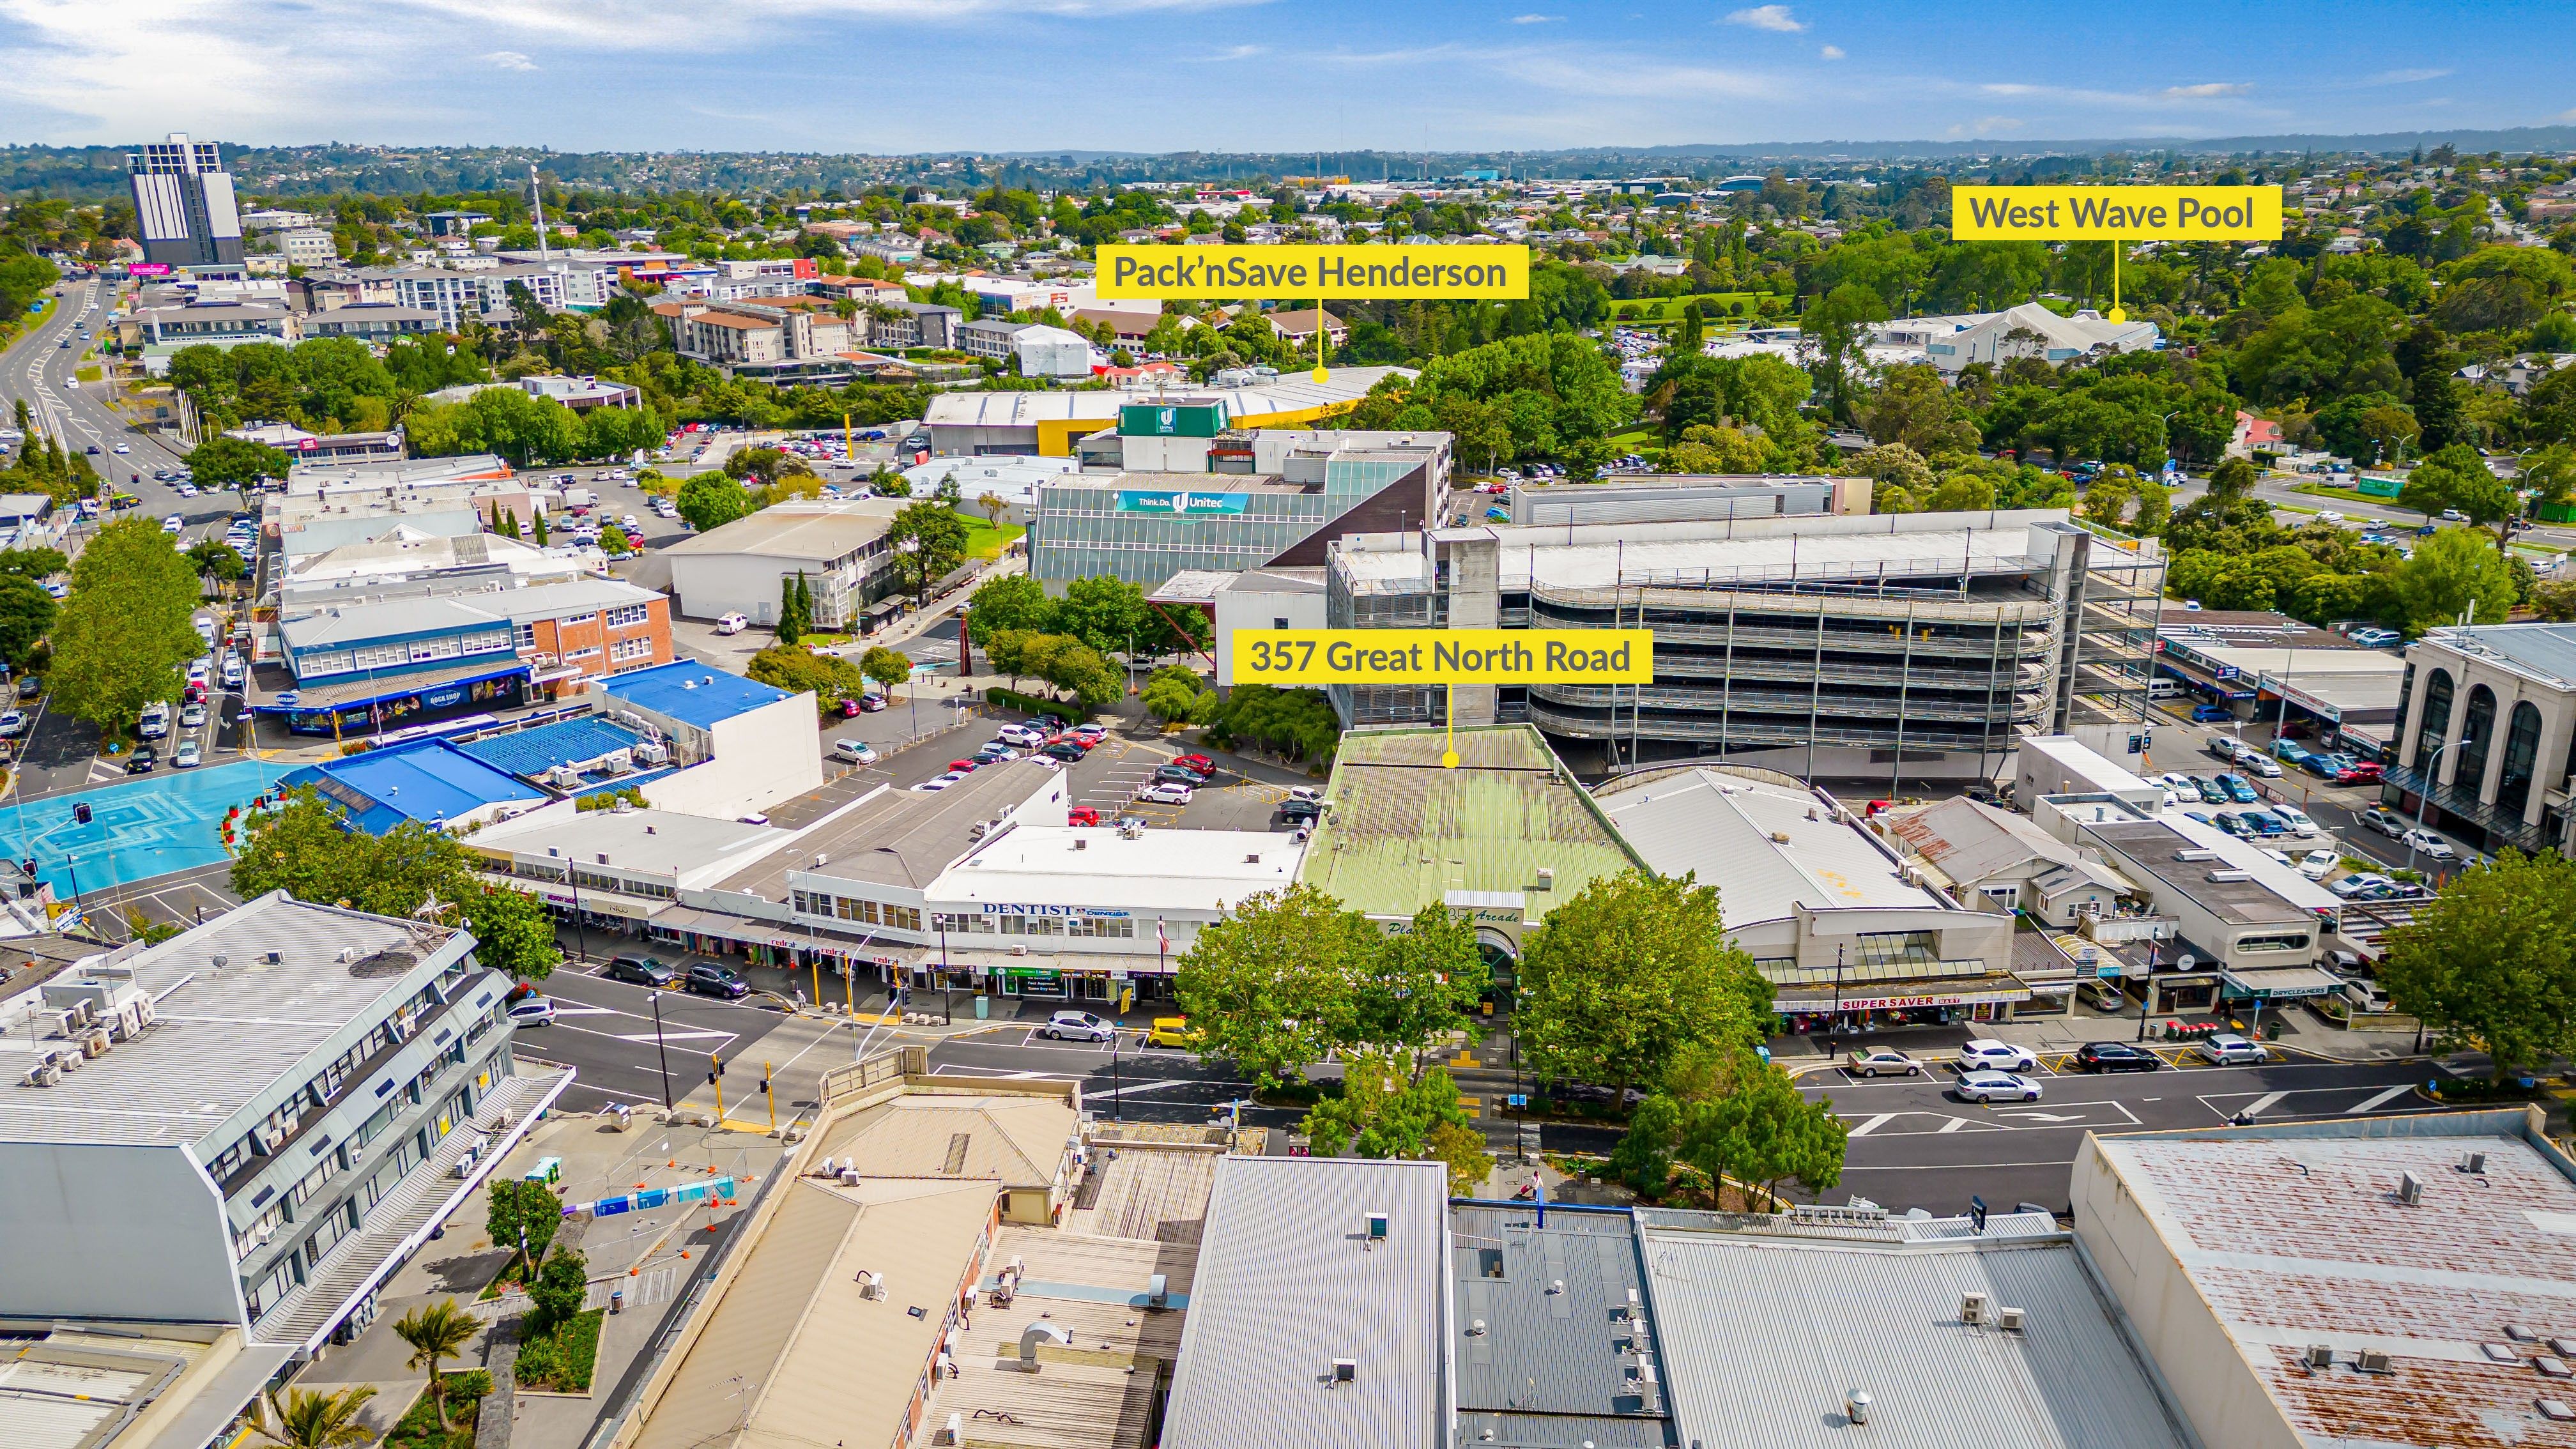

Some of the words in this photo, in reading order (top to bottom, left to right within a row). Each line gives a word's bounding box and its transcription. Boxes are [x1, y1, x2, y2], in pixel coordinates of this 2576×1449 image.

[1139, 498, 1158, 506] Think.
[1190, 497, 1223, 508] Unitec
[610, 904, 629, 914] NICO
[983, 903, 1075, 916] DENTIST
[1474, 909, 1519, 923] Arcade
[770, 939, 797, 948] redrat
[2273, 988, 2325, 997] DRYCLEANERS
[1843, 999, 1887, 1010] SUPER
[1889, 997, 1933, 1008] SAVER
